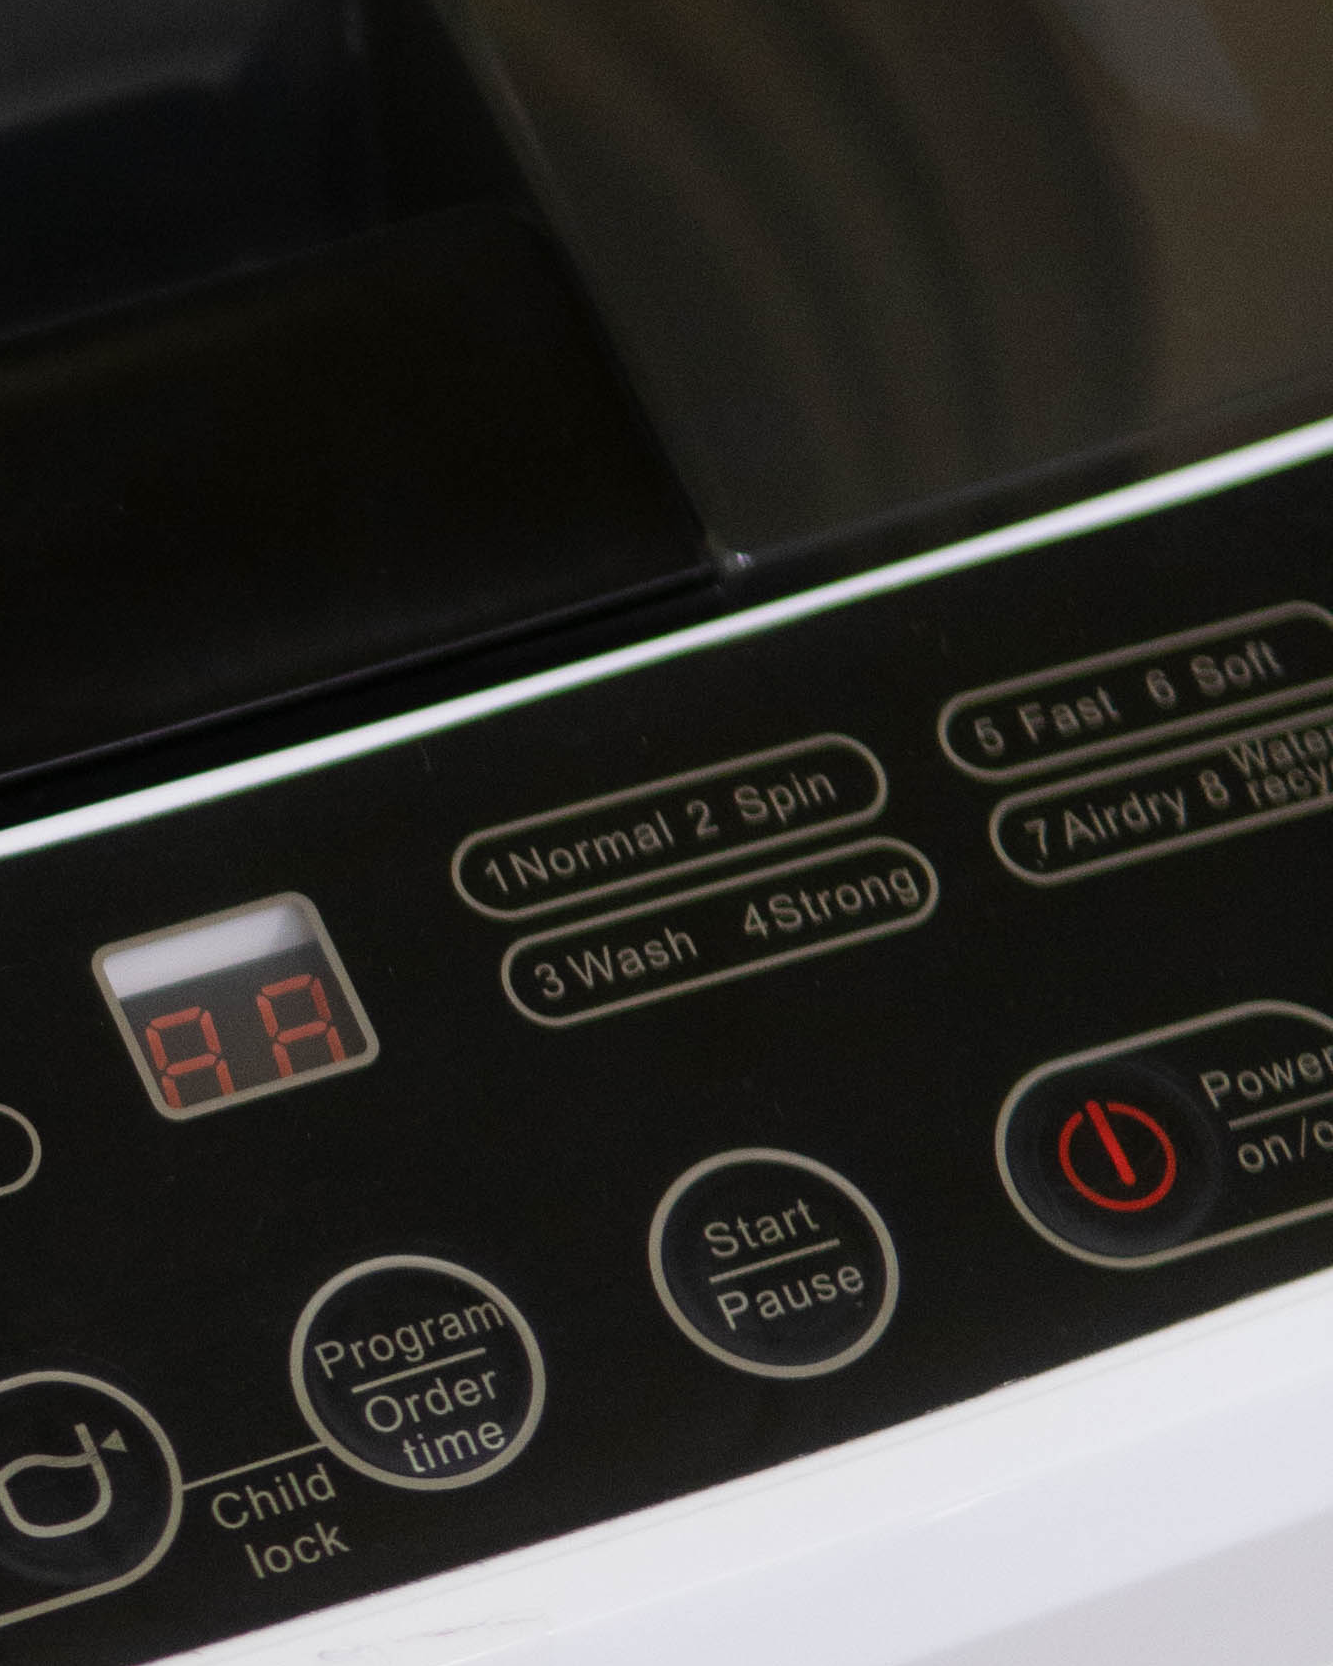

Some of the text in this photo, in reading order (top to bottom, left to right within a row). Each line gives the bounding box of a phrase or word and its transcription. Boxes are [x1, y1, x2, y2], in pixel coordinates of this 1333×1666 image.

[973, 640, 1286, 756] 5 Fast 6 Soft
[686, 799, 720, 837] 2
[733, 773, 838, 823] Spin
[1024, 819, 1050, 859] 7
[1198, 770, 1230, 809] 8
[704, 1200, 821, 1259] Start
[718, 1262, 865, 1331] Pause
[314, 1297, 506, 1381] Program
[365, 1365, 499, 1435] Order
[402, 1418, 507, 1474] time
[211, 1463, 337, 1532] Child
[244, 1520, 351, 1580] lock
